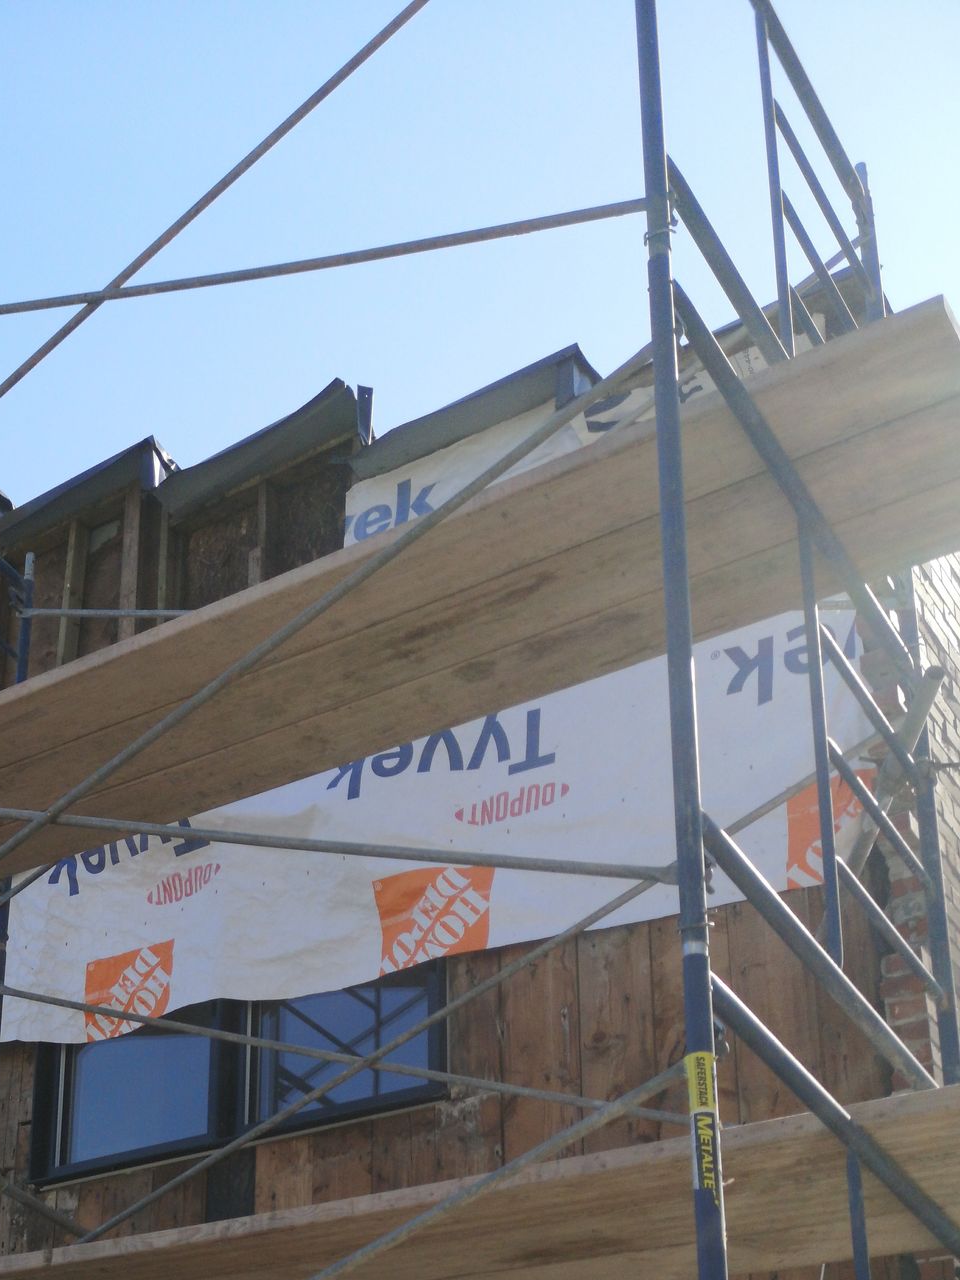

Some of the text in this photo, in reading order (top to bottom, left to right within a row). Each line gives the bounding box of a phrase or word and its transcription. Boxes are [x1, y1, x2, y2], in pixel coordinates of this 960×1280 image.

[468, 782, 556, 826] DUPONT
[152, 865, 213, 907] DUPONT
[695, 1056, 708, 1107] SAFERSTACK
[697, 1115, 716, 1191] METALTE
